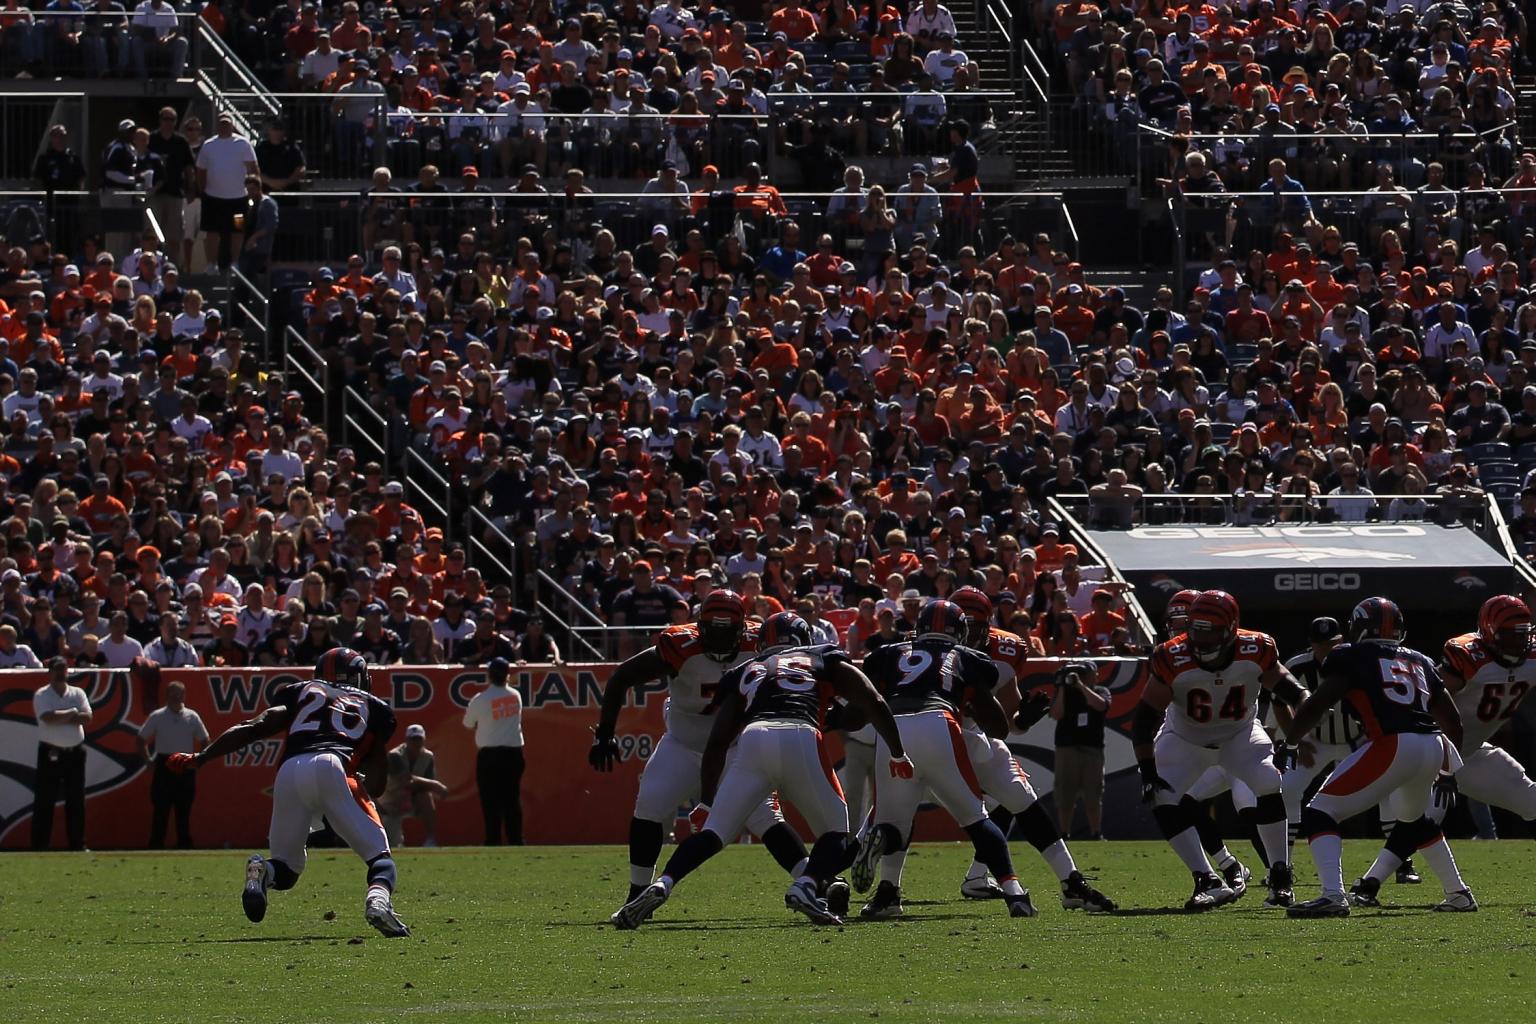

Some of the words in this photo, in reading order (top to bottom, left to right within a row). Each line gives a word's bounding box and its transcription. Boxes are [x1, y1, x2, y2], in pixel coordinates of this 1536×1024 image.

[1126, 525, 1427, 540] GEICO
[1274, 573, 1361, 592] GEICO
[1186, 684, 1248, 724] 64
[1477, 680, 1530, 723] 62
